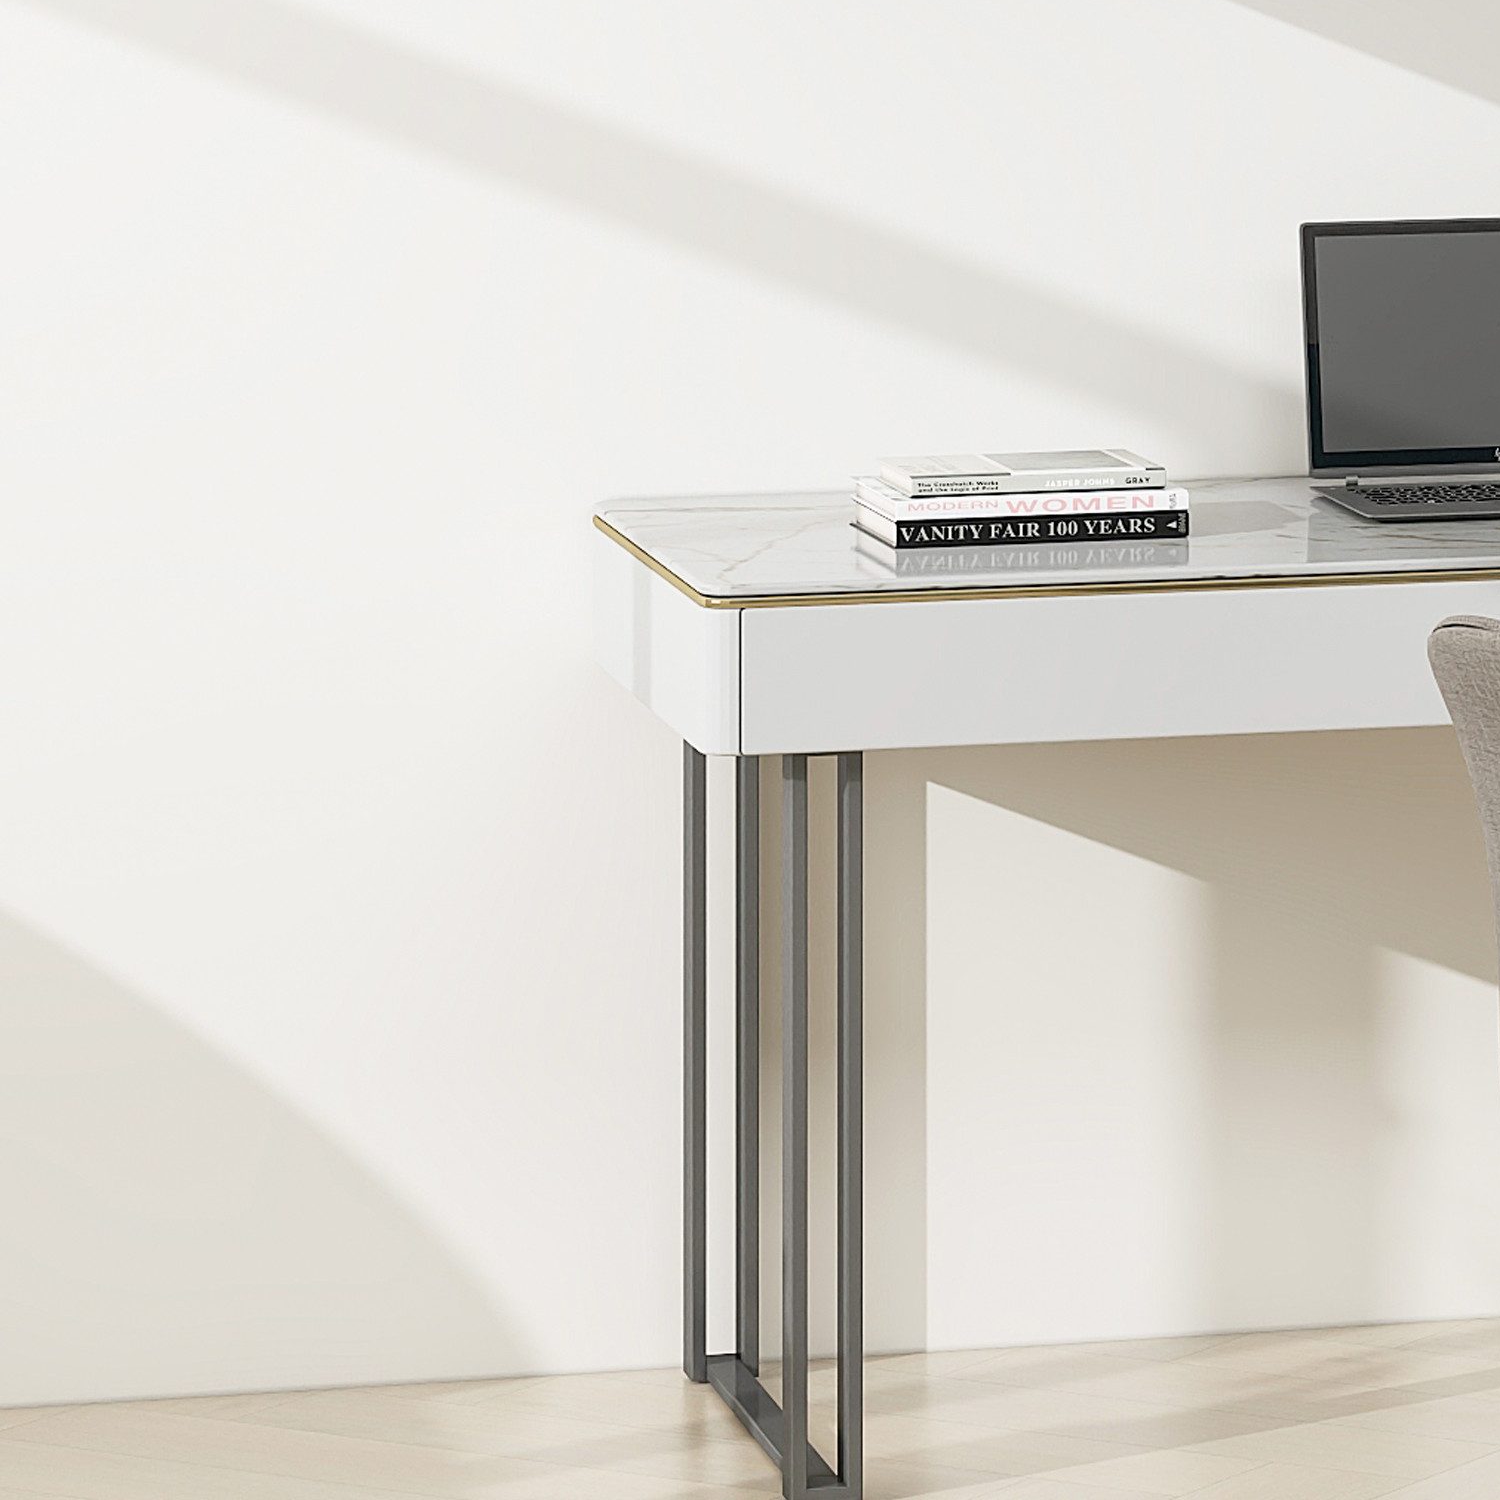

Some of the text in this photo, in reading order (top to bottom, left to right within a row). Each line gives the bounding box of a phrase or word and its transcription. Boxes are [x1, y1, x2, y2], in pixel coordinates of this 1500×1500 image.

[1044, 476, 1151, 487] JASPER JOHNS GRAY
[907, 500, 999, 512] MODERN
[1006, 495, 1154, 513] WOMEN
[900, 517, 1156, 542] VANITY FAIR 100 YEARS
